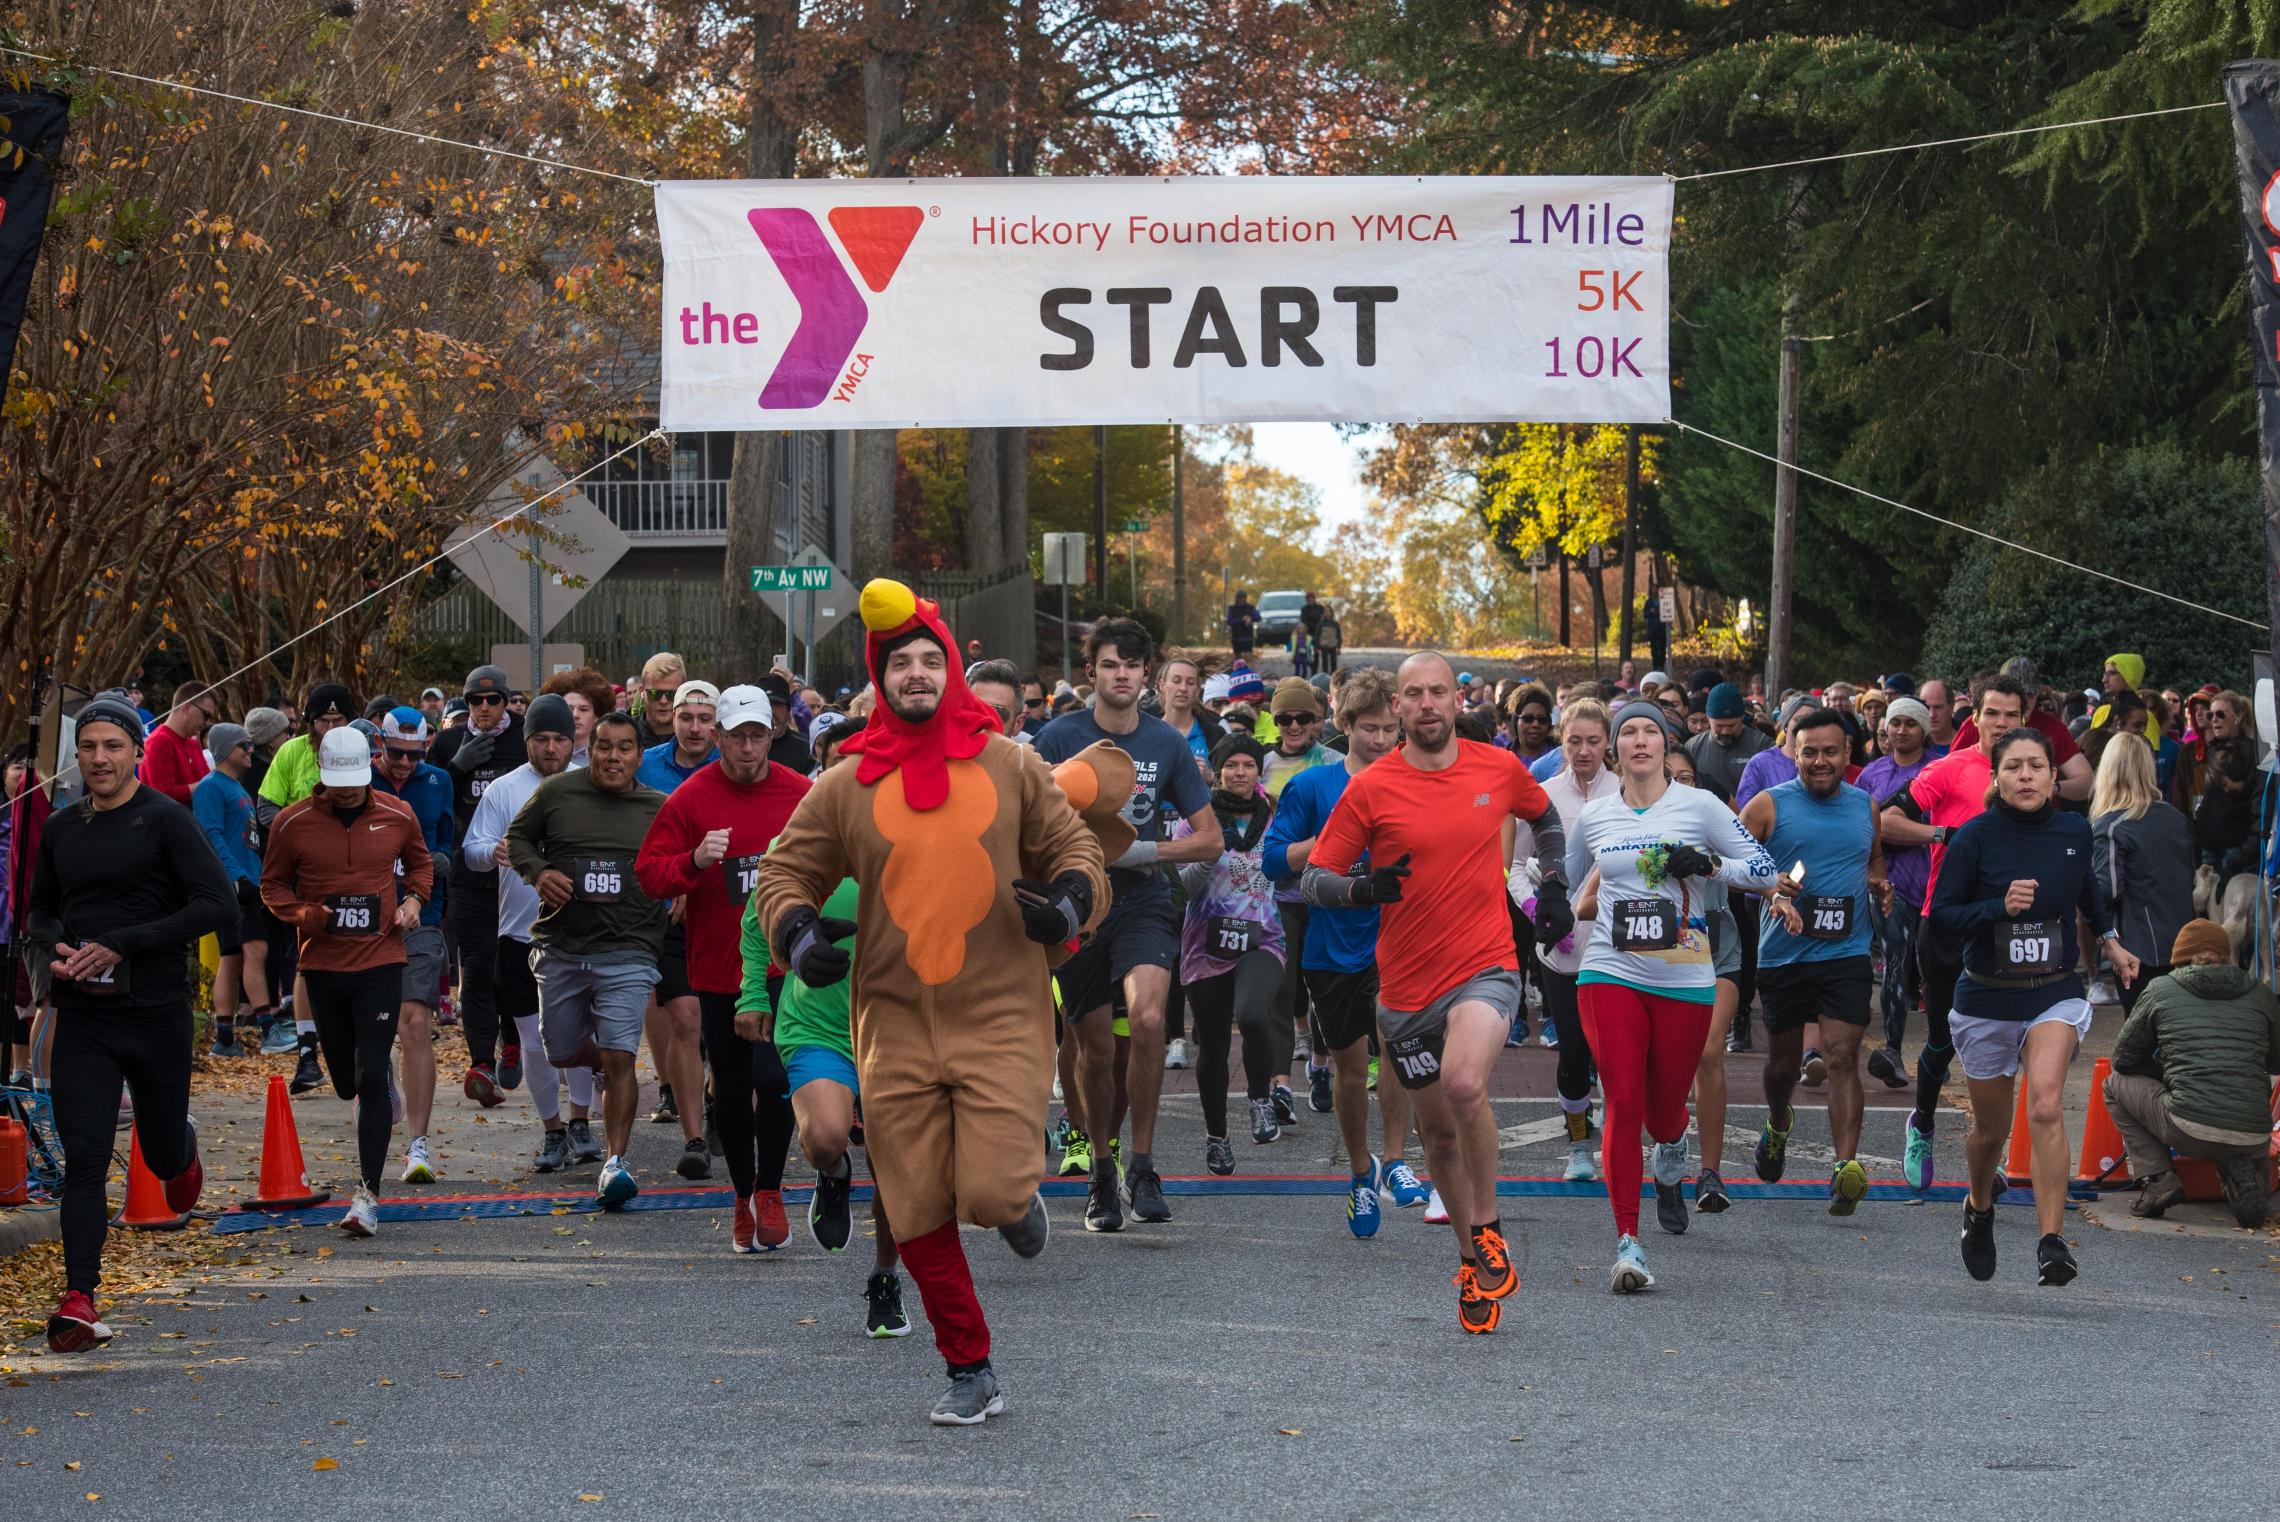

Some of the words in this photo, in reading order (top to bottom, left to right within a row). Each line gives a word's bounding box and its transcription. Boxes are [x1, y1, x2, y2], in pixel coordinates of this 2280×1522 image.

[972, 215, 1111, 251] Hickory
[1129, 214, 1335, 244] Foundation
[1352, 214, 1458, 241] YMCA
[1509, 203, 1645, 245] 1Mile
[1577, 270, 1644, 312] 5K
[680, 302, 759, 345] the
[1040, 285, 1399, 371] START
[1545, 336, 1644, 378] 10K
[833, 354, 874, 402] YMCA
[753, 569, 774, 587] 7th
[778, 569, 797, 587] Av
[802, 569, 828, 587] NW
[331, 756, 360, 767] HOKA
[1137, 773, 1157, 781] 2021
[584, 872, 621, 894] 695
[336, 908, 370, 928] 763
[1624, 915, 1663, 940] 748
[1813, 909, 1845, 931] 743
[1219, 929, 1249, 952] 731
[2009, 937, 2050, 963] 697
[1397, 1051, 1440, 1079] 749
